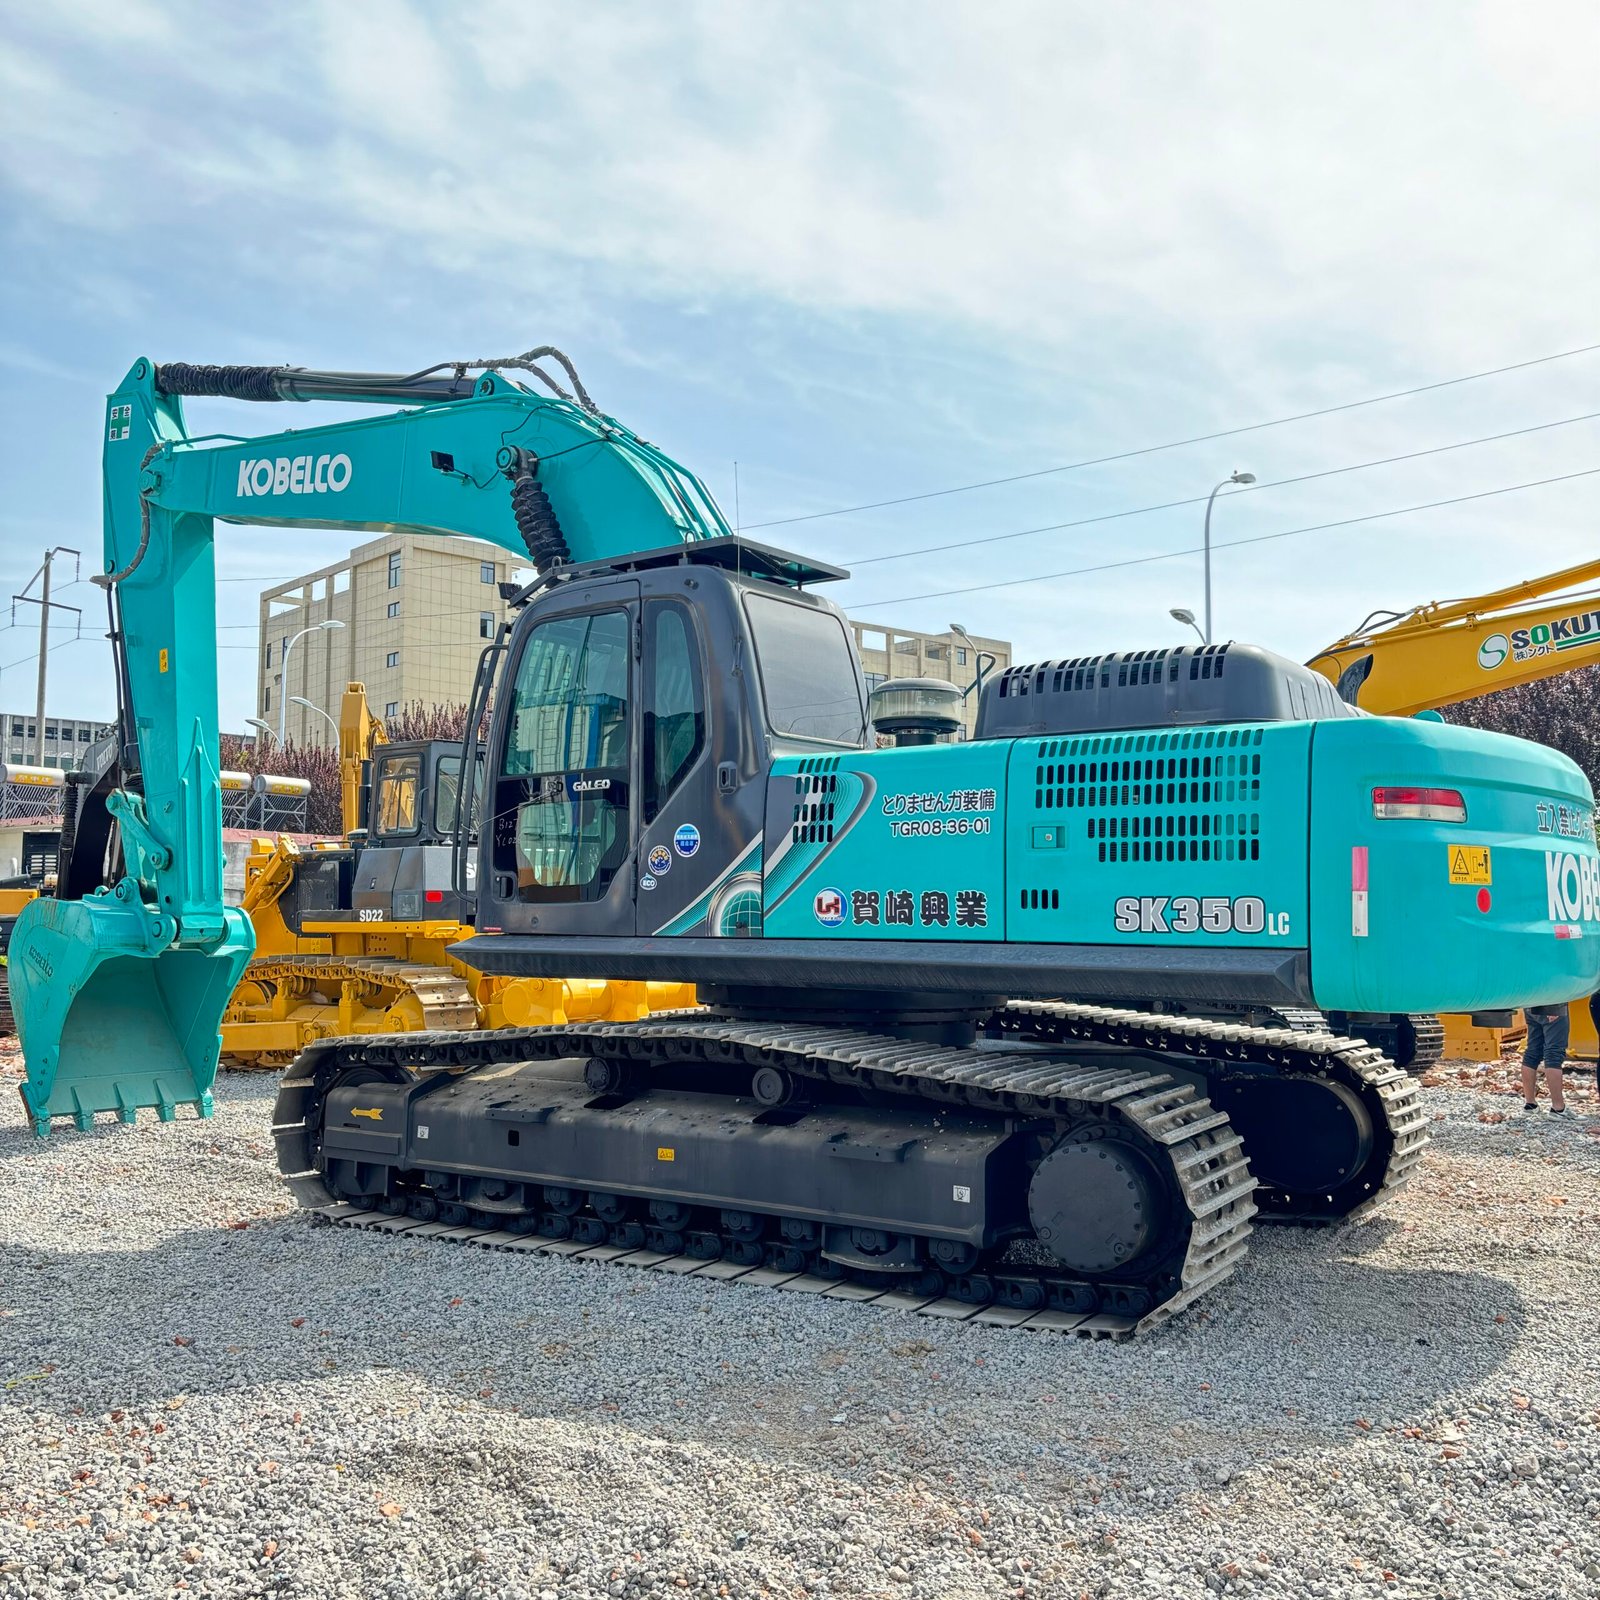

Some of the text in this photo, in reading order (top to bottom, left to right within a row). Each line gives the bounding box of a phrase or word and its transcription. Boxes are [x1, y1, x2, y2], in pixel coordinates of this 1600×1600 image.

[236, 453, 352, 497] KOBELCO
[573, 779, 611, 792] GALEO
[890, 818, 991, 837] TGR08-36-01
[642, 879, 656, 887] ECO
[1545, 850, 1600, 922] KOBE
[360, 909, 384, 922] SD22
[851, 890, 988, 927] 賀崎興業
[1115, 896, 1290, 935] SK350 LC
